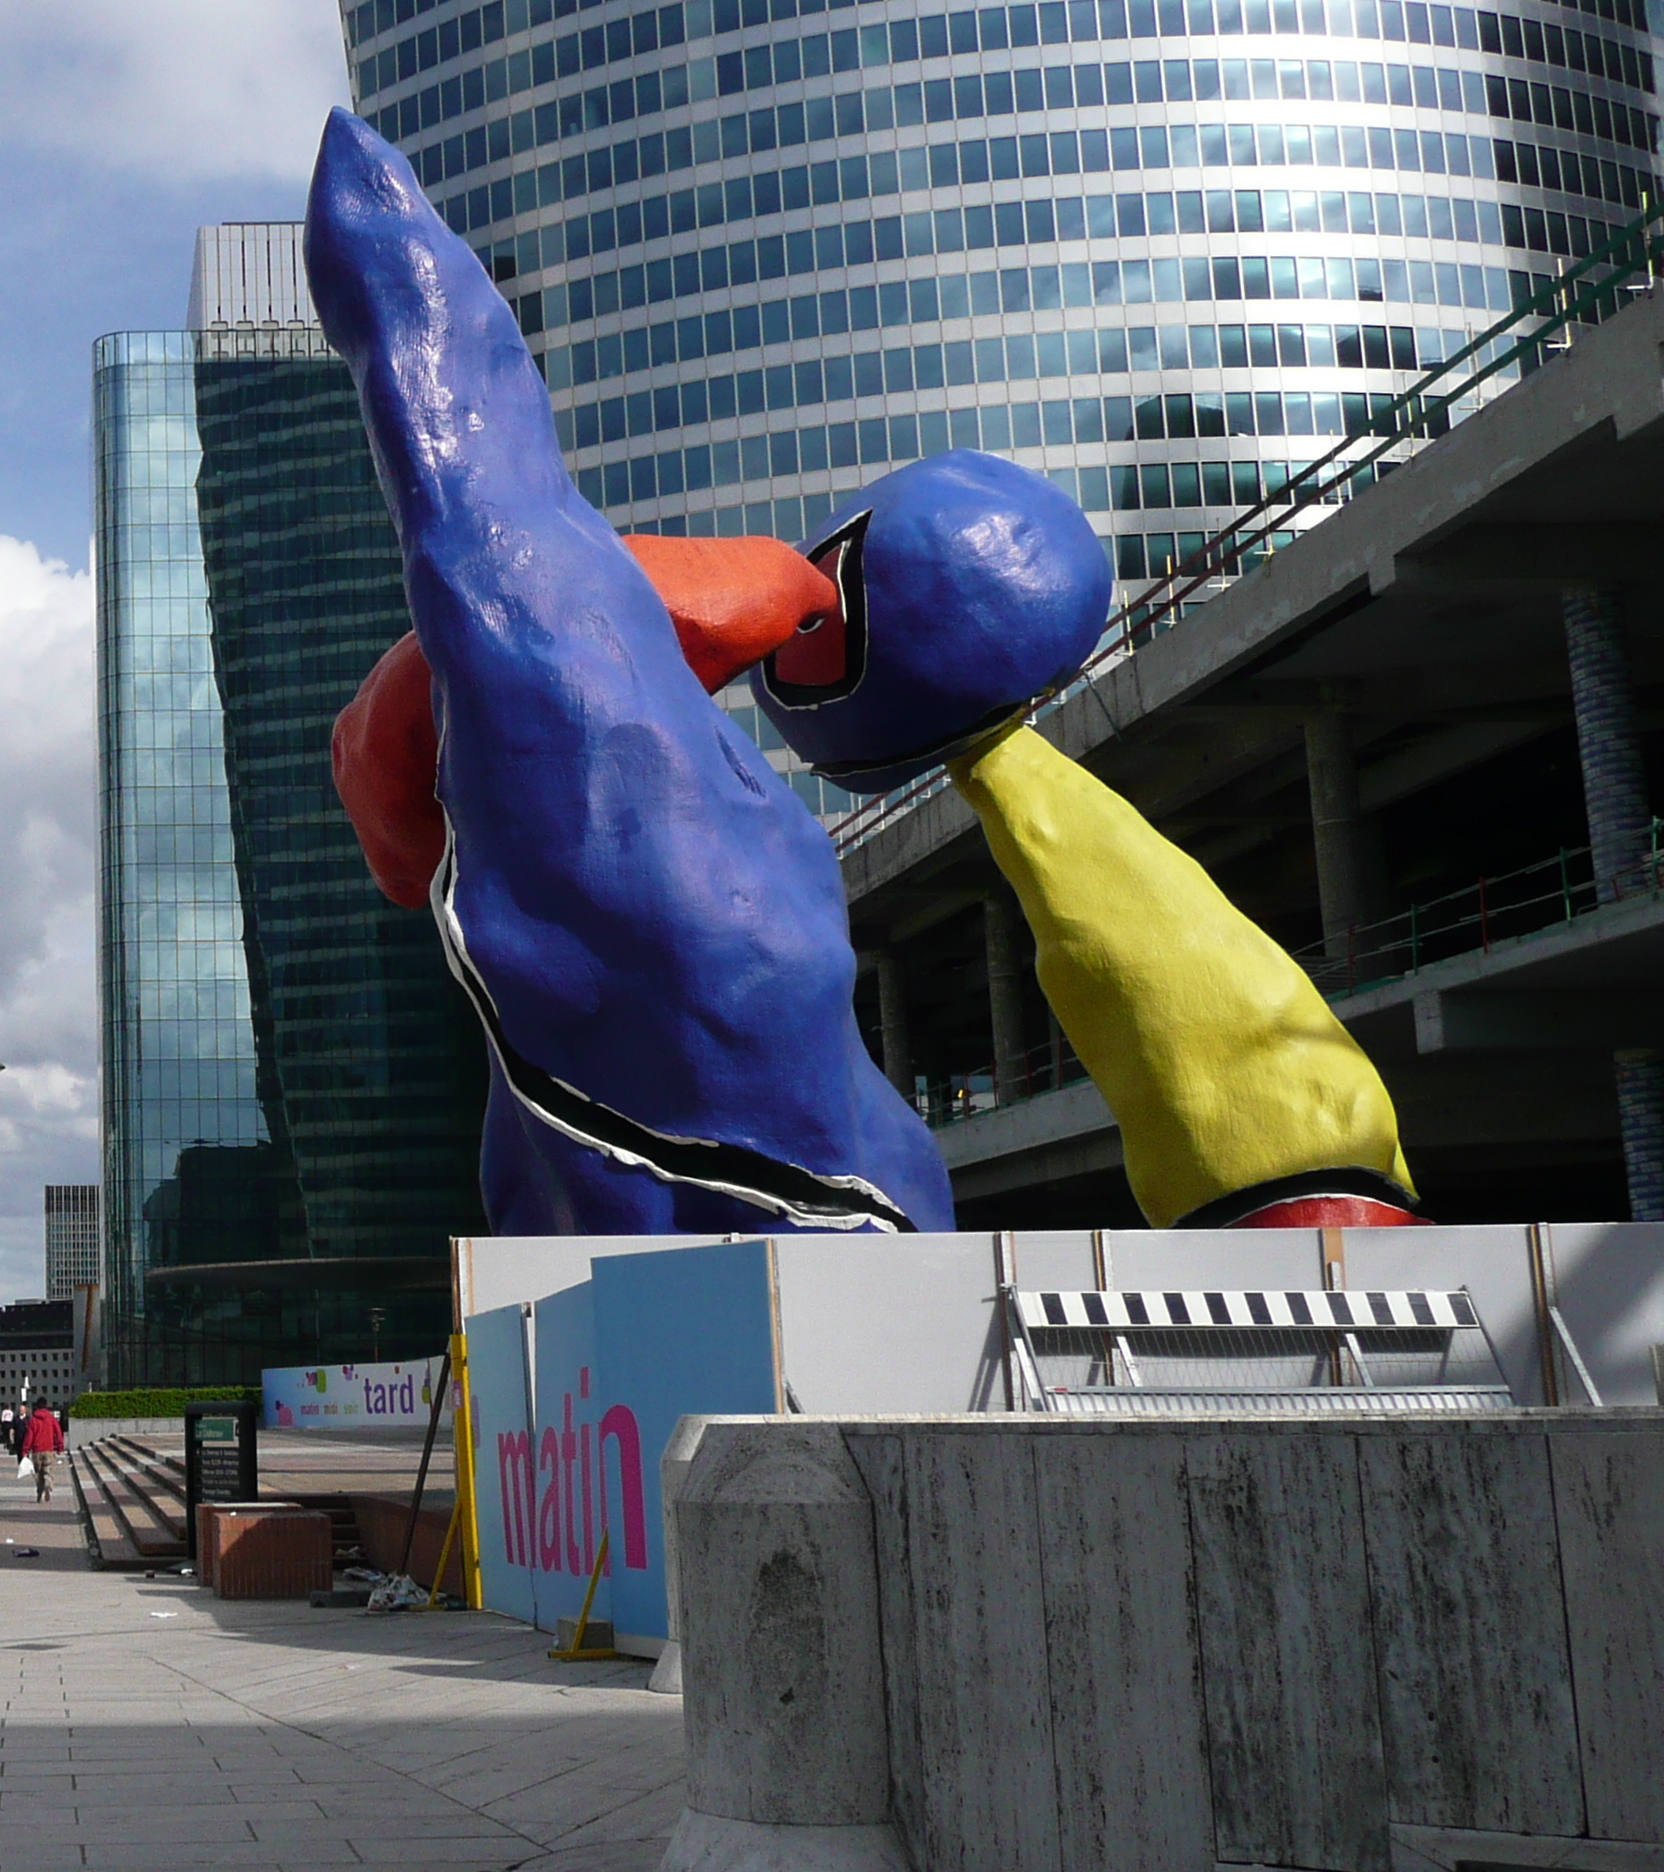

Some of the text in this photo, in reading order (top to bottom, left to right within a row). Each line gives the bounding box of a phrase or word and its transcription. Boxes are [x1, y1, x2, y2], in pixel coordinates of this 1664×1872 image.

[300, 1402, 319, 1415] matin
[323, 1401, 338, 1415] midi
[364, 1374, 414, 1414] tard
[497, 1366, 648, 1577] matin
